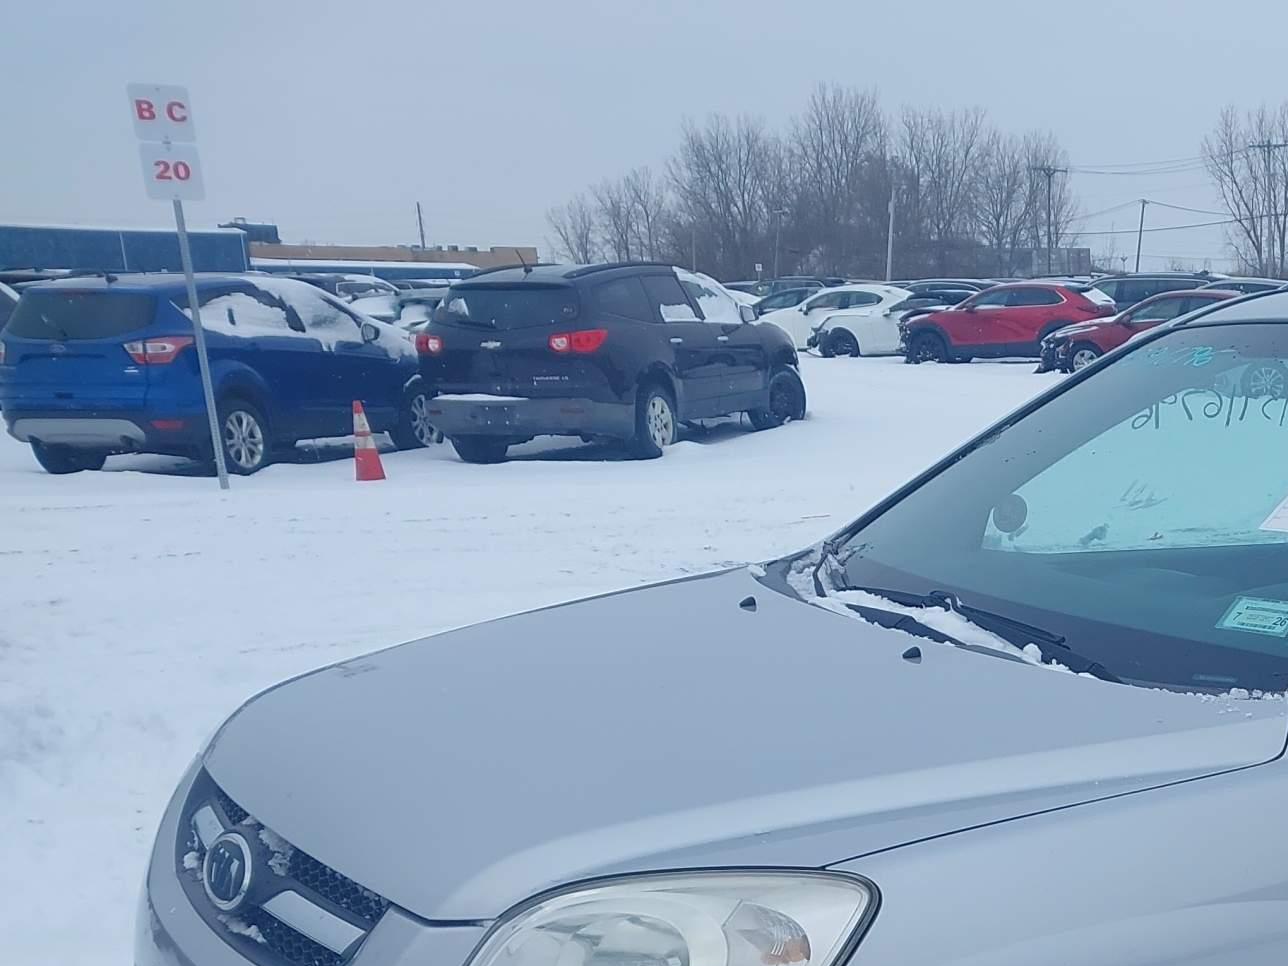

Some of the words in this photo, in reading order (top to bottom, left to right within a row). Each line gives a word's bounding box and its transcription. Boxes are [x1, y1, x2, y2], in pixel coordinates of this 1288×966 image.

[135, 99, 156, 120] B
[166, 101, 187, 122] C
[154, 160, 191, 181] 20
[1272, 616, 1288, 627] 26
